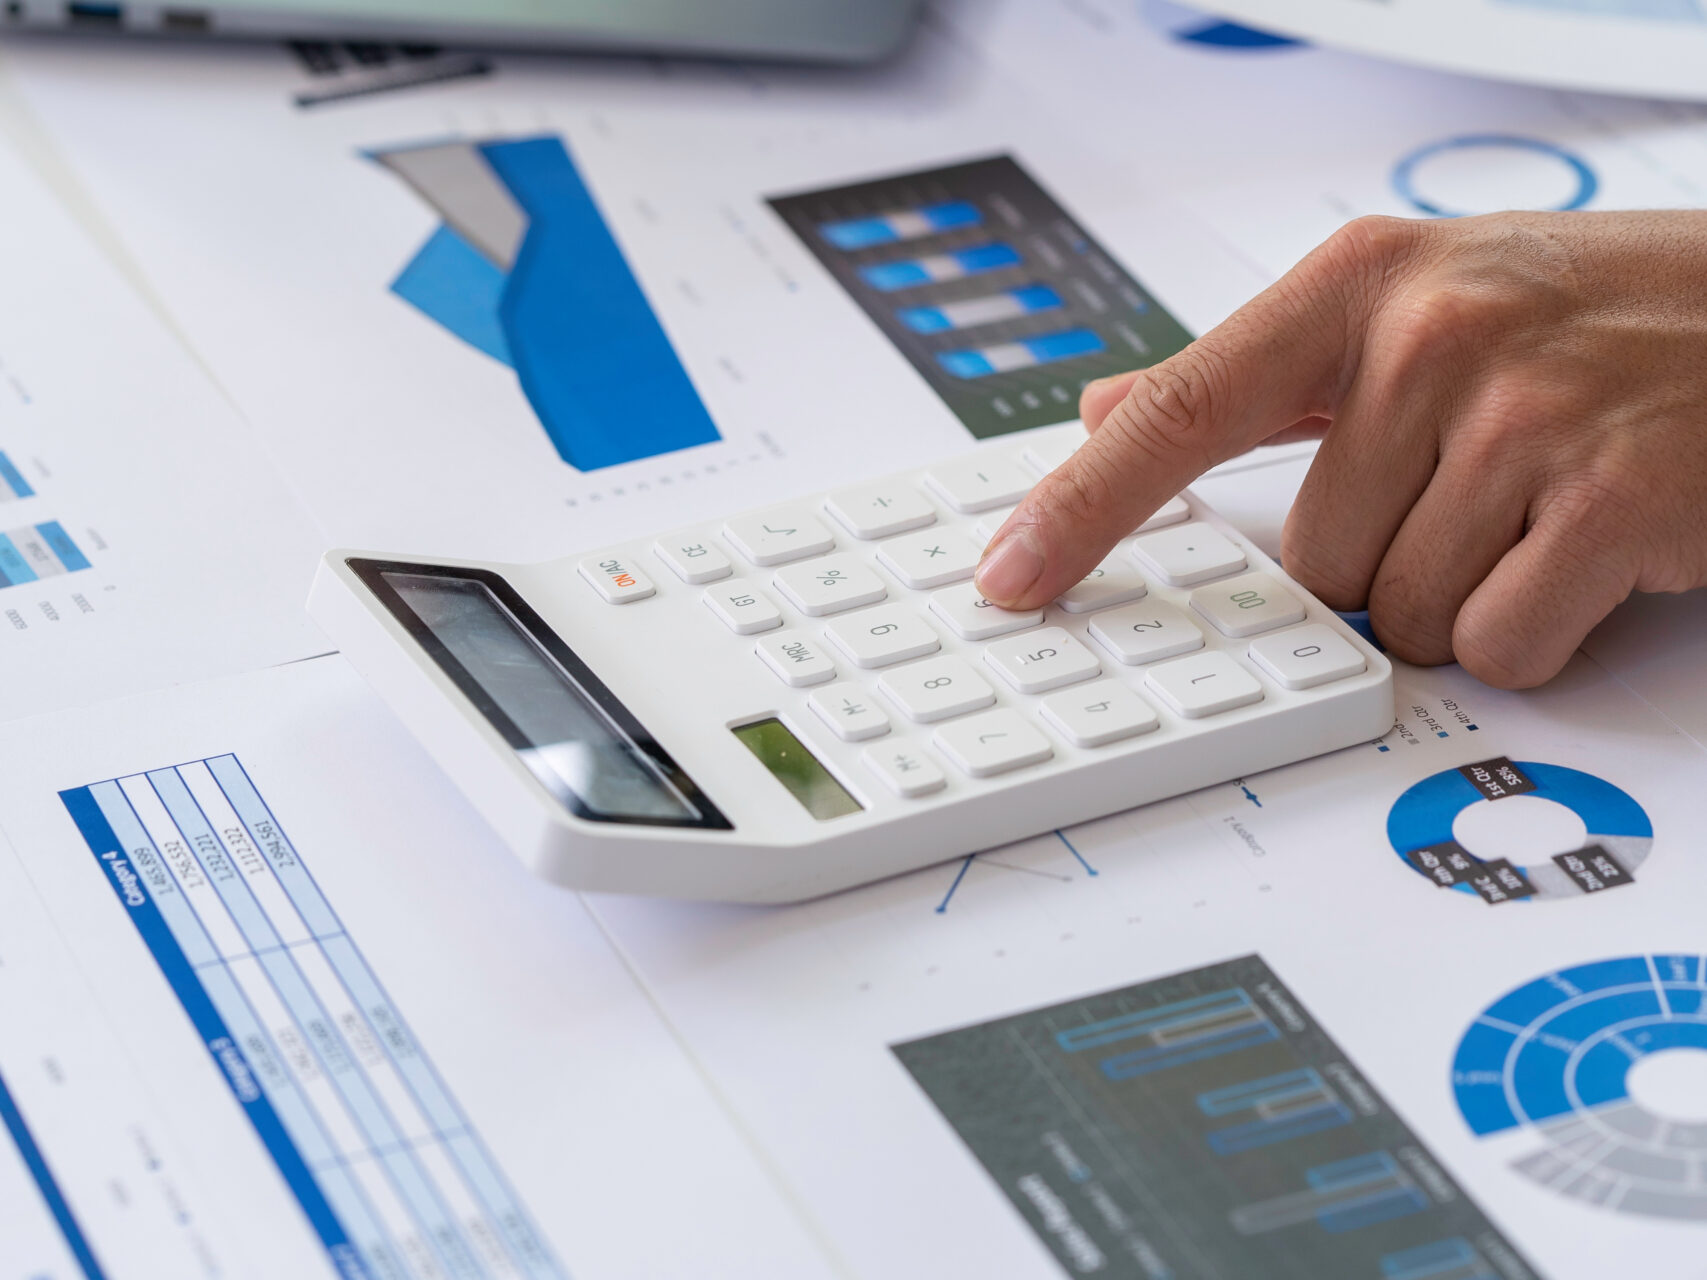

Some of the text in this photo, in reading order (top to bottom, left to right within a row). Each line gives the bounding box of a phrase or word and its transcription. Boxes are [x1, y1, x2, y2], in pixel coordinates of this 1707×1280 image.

[681, 544, 708, 558] CE
[599, 559, 637, 588] ON/AC
[816, 570, 848, 586] %
[729, 593, 756, 607] GT
[1230, 590, 1266, 610] 00
[870, 623, 898, 636] 9
[1133, 620, 1163, 633] 2
[781, 642, 815, 663] MRC
[1028, 648, 1058, 662] 5
[1293, 645, 1321, 658] 0
[923, 677, 952, 690] 8
[1191, 673, 1217, 685] 1
[1084, 701, 1111, 713] 4
[1441, 698, 1470, 724] 4th Qtr
[1412, 705, 1443, 732] 3rd Qtr
[979, 733, 1009, 744] 7
[1471, 767, 1506, 797] 1st Qtr
[1496, 766, 1523, 787] 58%
[194, 833, 235, 882] 1,232,221
[224, 827, 266, 875] 1,112,322
